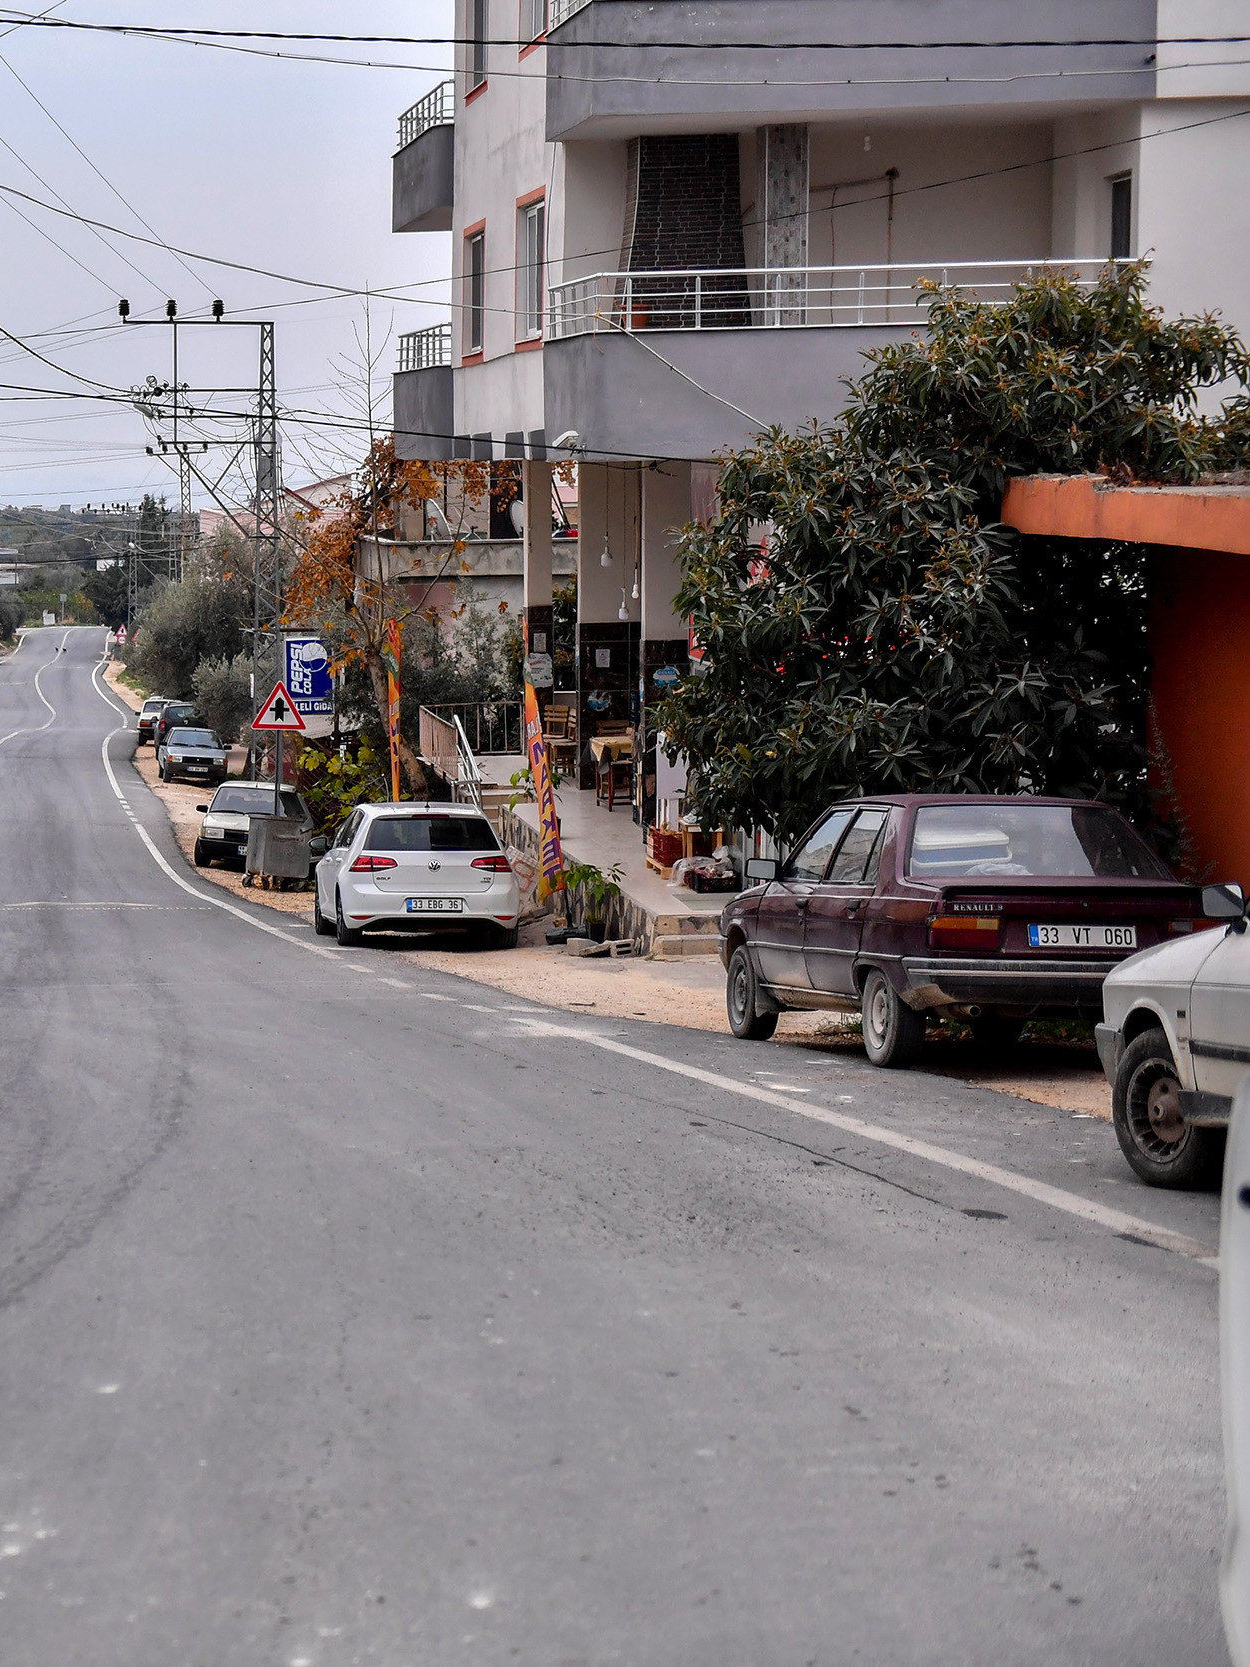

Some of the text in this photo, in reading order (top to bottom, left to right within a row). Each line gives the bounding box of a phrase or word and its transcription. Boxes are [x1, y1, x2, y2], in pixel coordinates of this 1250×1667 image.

[291, 643, 303, 693] PEPSI
[303, 668, 312, 695] COLA
[295, 701, 312, 711] LELİ
[412, 900, 459, 909] 33 EBG 36
[1040, 927, 1133, 946] 33 VT 060
